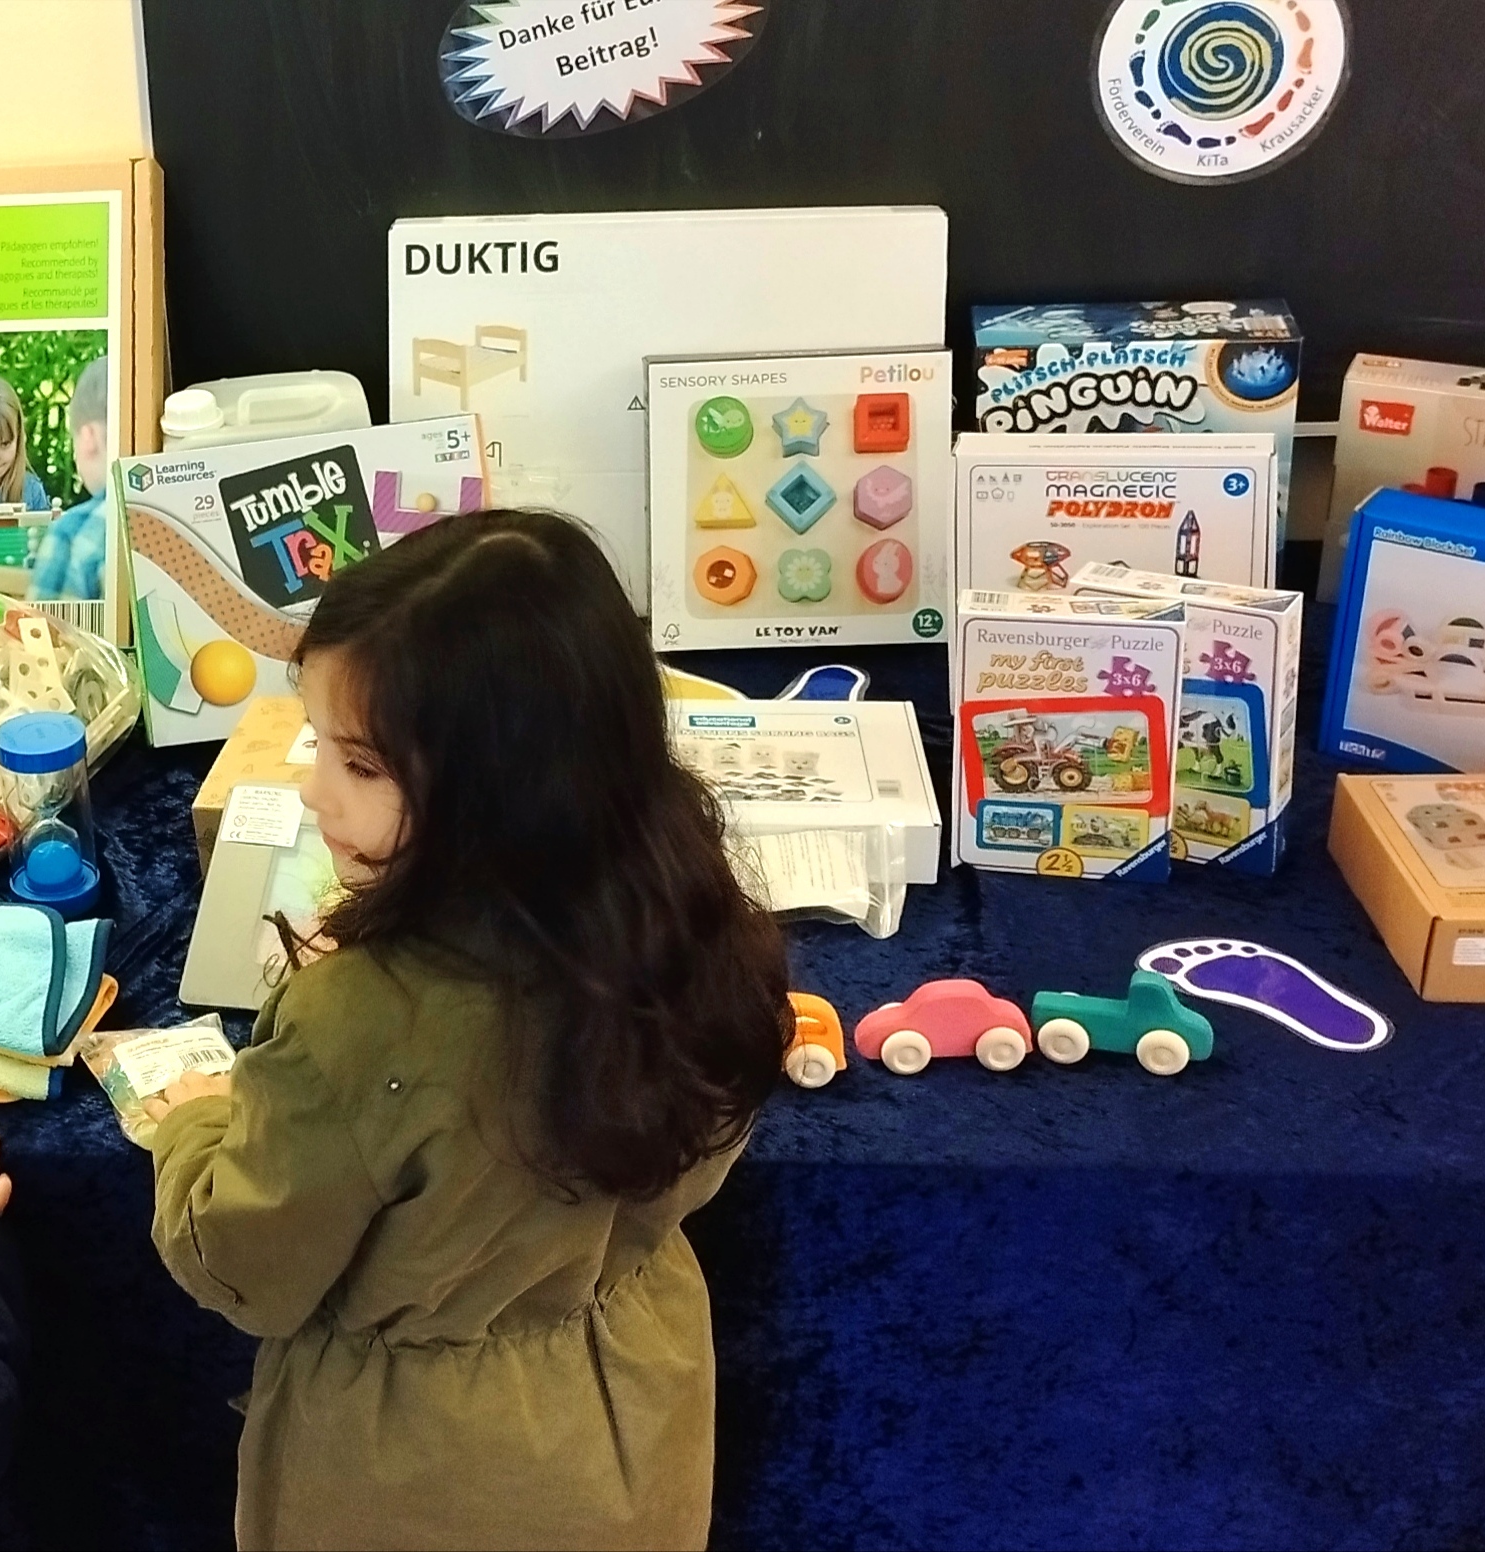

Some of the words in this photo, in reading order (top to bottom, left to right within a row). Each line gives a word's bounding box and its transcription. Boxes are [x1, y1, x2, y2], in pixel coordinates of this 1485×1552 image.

[498, 15, 575, 50] Danke
[580, 0, 615, 24] für
[556, 27, 659, 77] Beitrag!
[1108, 78, 1165, 156] Förderverein
[1196, 154, 1229, 167] KiTa
[0, 241, 48, 254] Pädagogen
[49, 239, 99, 252] empfohlen!
[21, 256, 86, 268] Recommended
[87, 256, 99, 268] by
[405, 241, 559, 275] DUKTIG
[36, 271, 53, 280] and
[55, 268, 99, 281] therapists!
[23, 287, 82, 298] Recommandé
[84, 287, 98, 298] par
[21, 301, 30, 310] et
[31, 300, 43, 310] les
[660, 375, 727, 389] SENSORY
[731, 372, 787, 385] SHAPES
[860, 364, 934, 384] Petilou
[1363, 412, 1409, 431] Walter
[447, 429, 472, 449] 5+
[1463, 416, 1485, 447] ST
[156, 461, 205, 474] Learning
[156, 471, 215, 485] Resources
[1227, 478, 1246, 491] 3+
[229, 460, 347, 533] Tumble
[1046, 484, 1177, 498] MAGNETIC
[194, 495, 214, 511] 29
[1046, 500, 1176, 519] POLYDRON
[1373, 526, 1422, 547] Rainbow
[1456, 543, 1477, 557] Set
[917, 613, 941, 627] 12+
[1213, 619, 1263, 640] Puzzle
[755, 627, 771, 637] LE
[775, 627, 805, 637] TOY
[809, 625, 839, 636] VAN
[978, 629, 1089, 649] Ravensburger
[1111, 635, 1164, 651] Puzzle
[990, 653, 1027, 671] my
[1029, 650, 1085, 672] first
[1214, 657, 1241, 674] 3x6
[976, 671, 1089, 693] puzzles
[1112, 673, 1141, 687] 3x6
[1218, 831, 1268, 865] Ravensburger
[1115, 838, 1167, 878] Ravensburger
